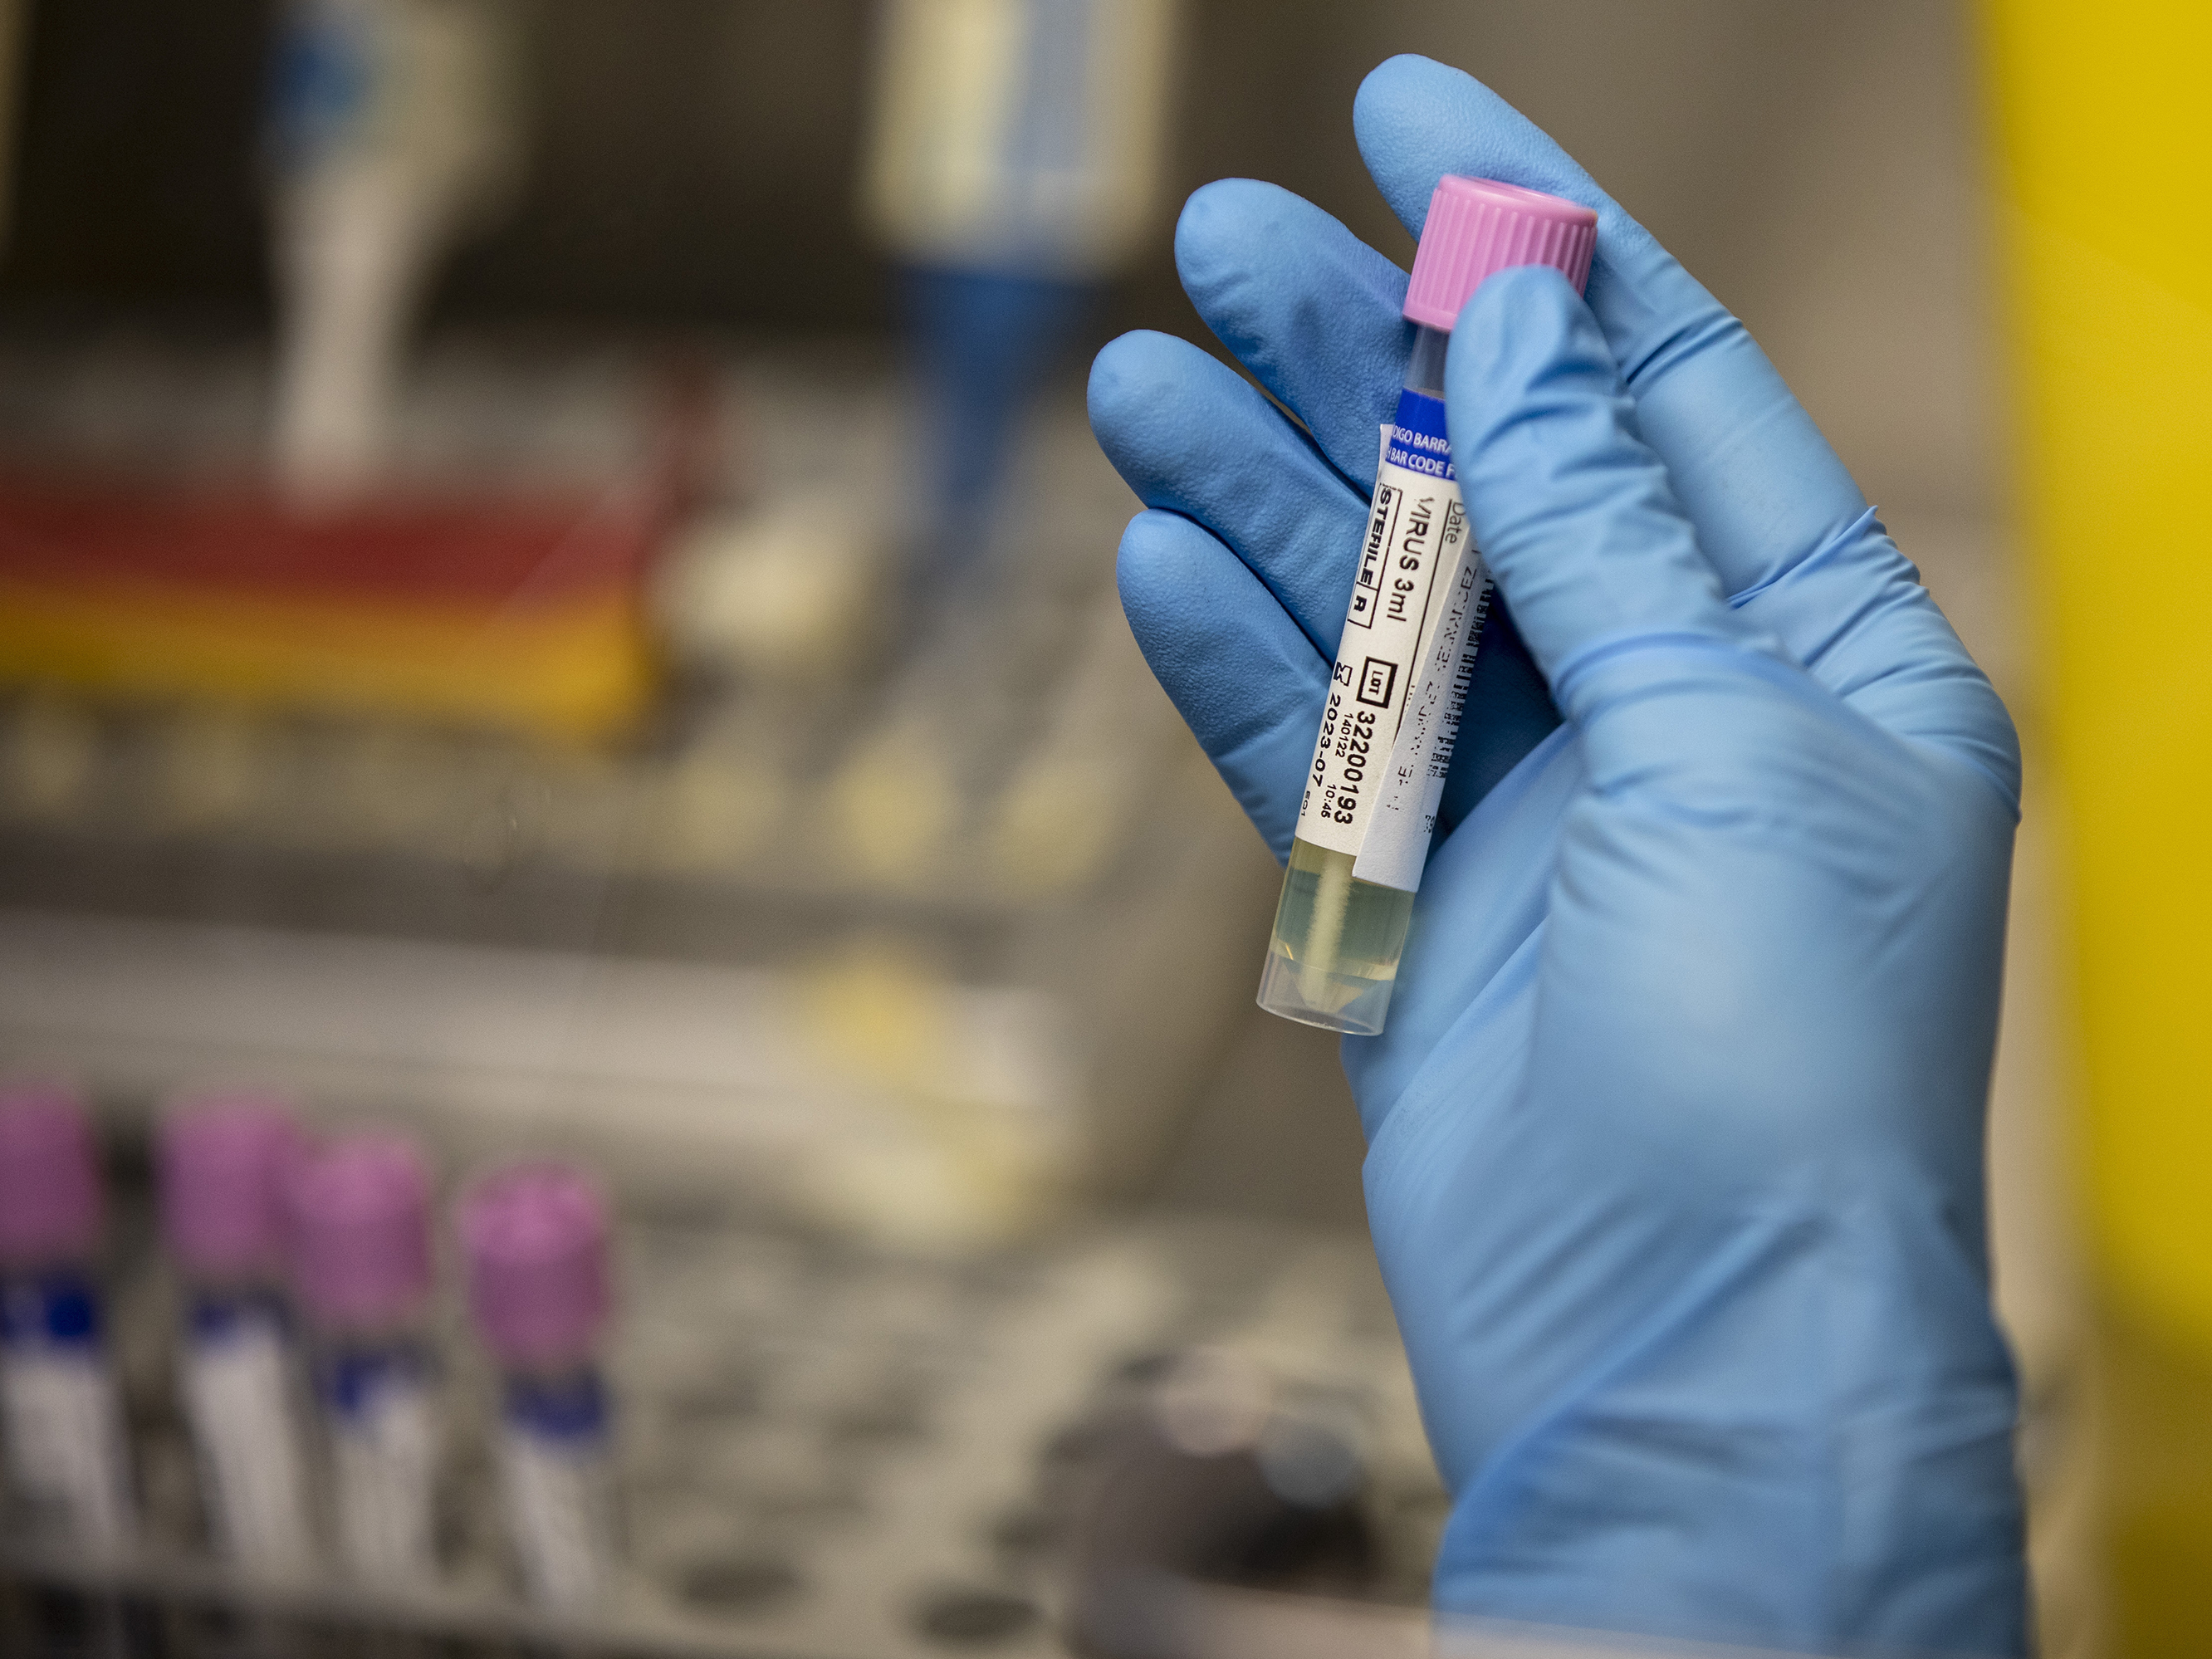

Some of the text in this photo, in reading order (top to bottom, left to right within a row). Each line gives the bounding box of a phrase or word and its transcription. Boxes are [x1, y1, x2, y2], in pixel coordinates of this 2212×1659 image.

[1391, 448, 1407, 464] BAR
[1408, 454, 1445, 475] CODE
[1360, 487, 1392, 585] STERILE
[1387, 497, 1435, 622] VIRUS 3ml
[1446, 502, 1466, 544] Date
[1313, 692, 1341, 787] 2023-07
[1334, 670, 1383, 825] LOT 32200193
[1335, 713, 1353, 757] 140122
